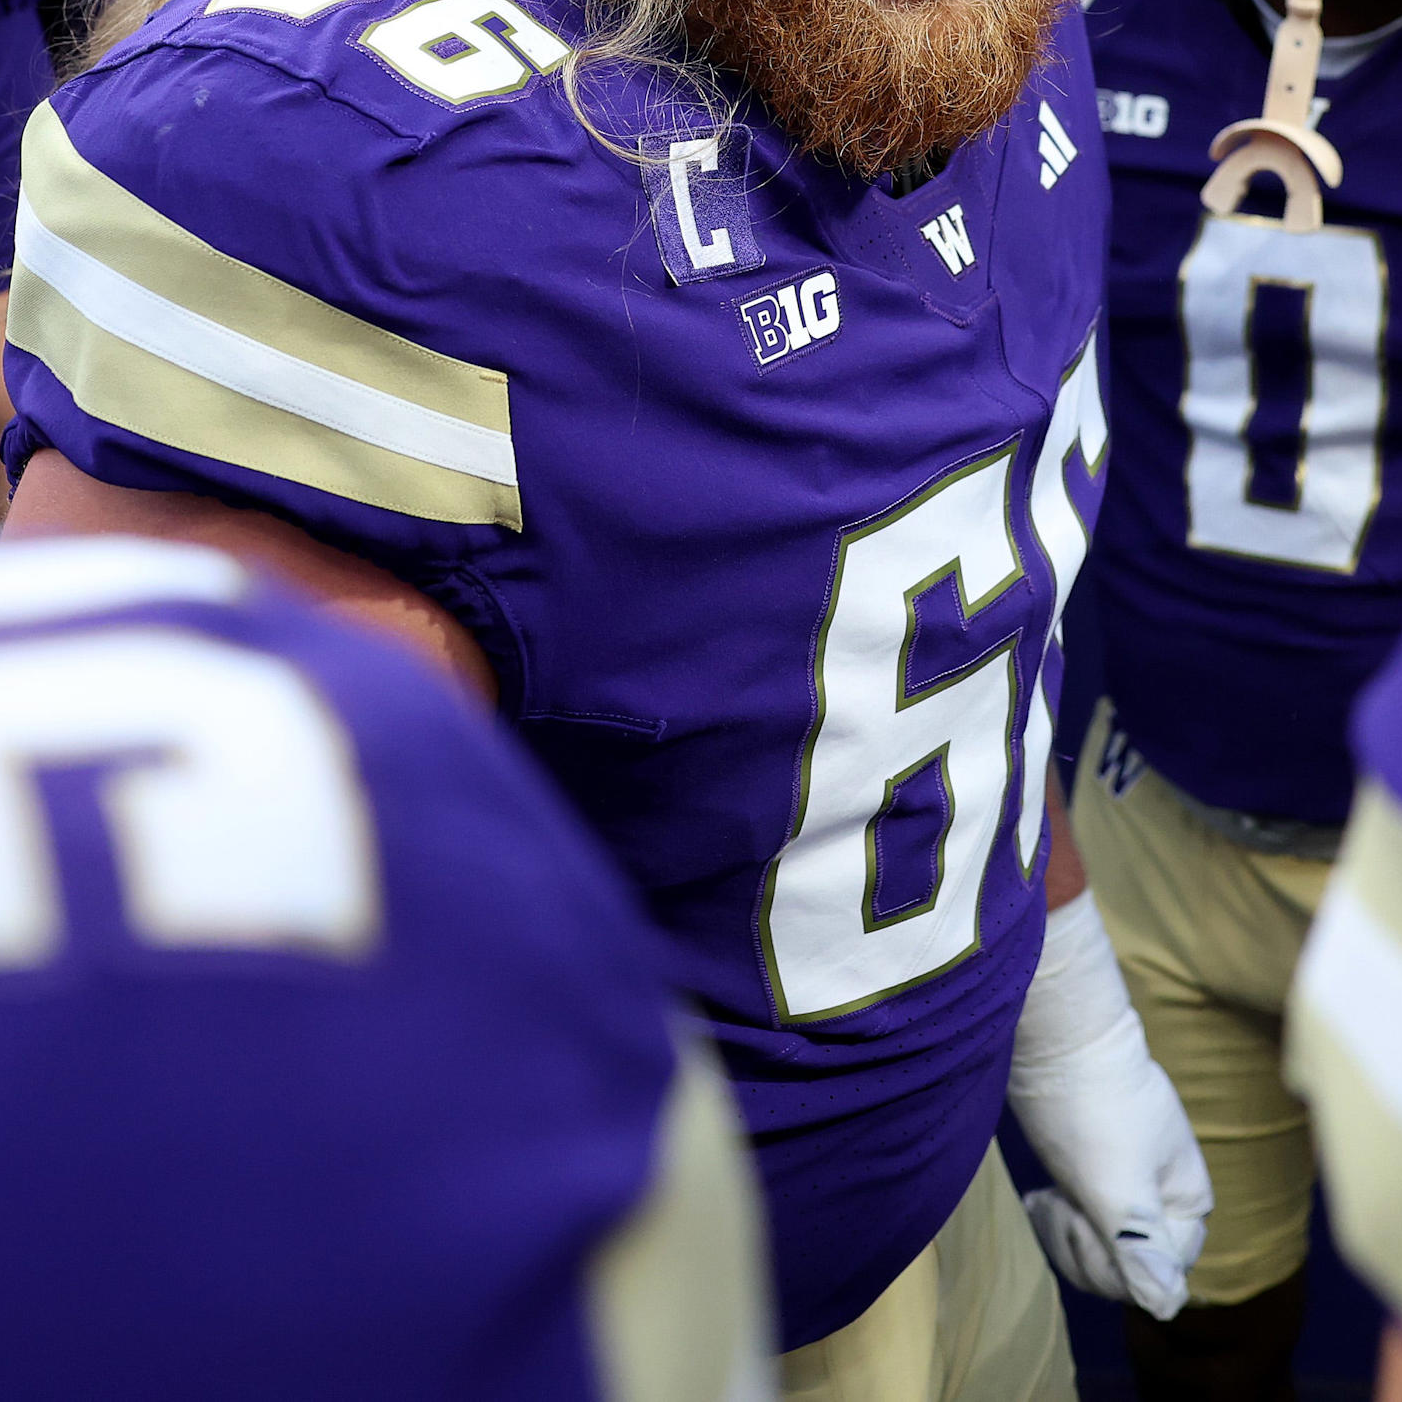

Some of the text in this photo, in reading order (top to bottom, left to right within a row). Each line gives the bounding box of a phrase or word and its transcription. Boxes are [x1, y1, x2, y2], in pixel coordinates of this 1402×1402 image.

[669, 138, 736, 271] C
[921, 204, 977, 277] W
[1177, 210, 1389, 576] 0
